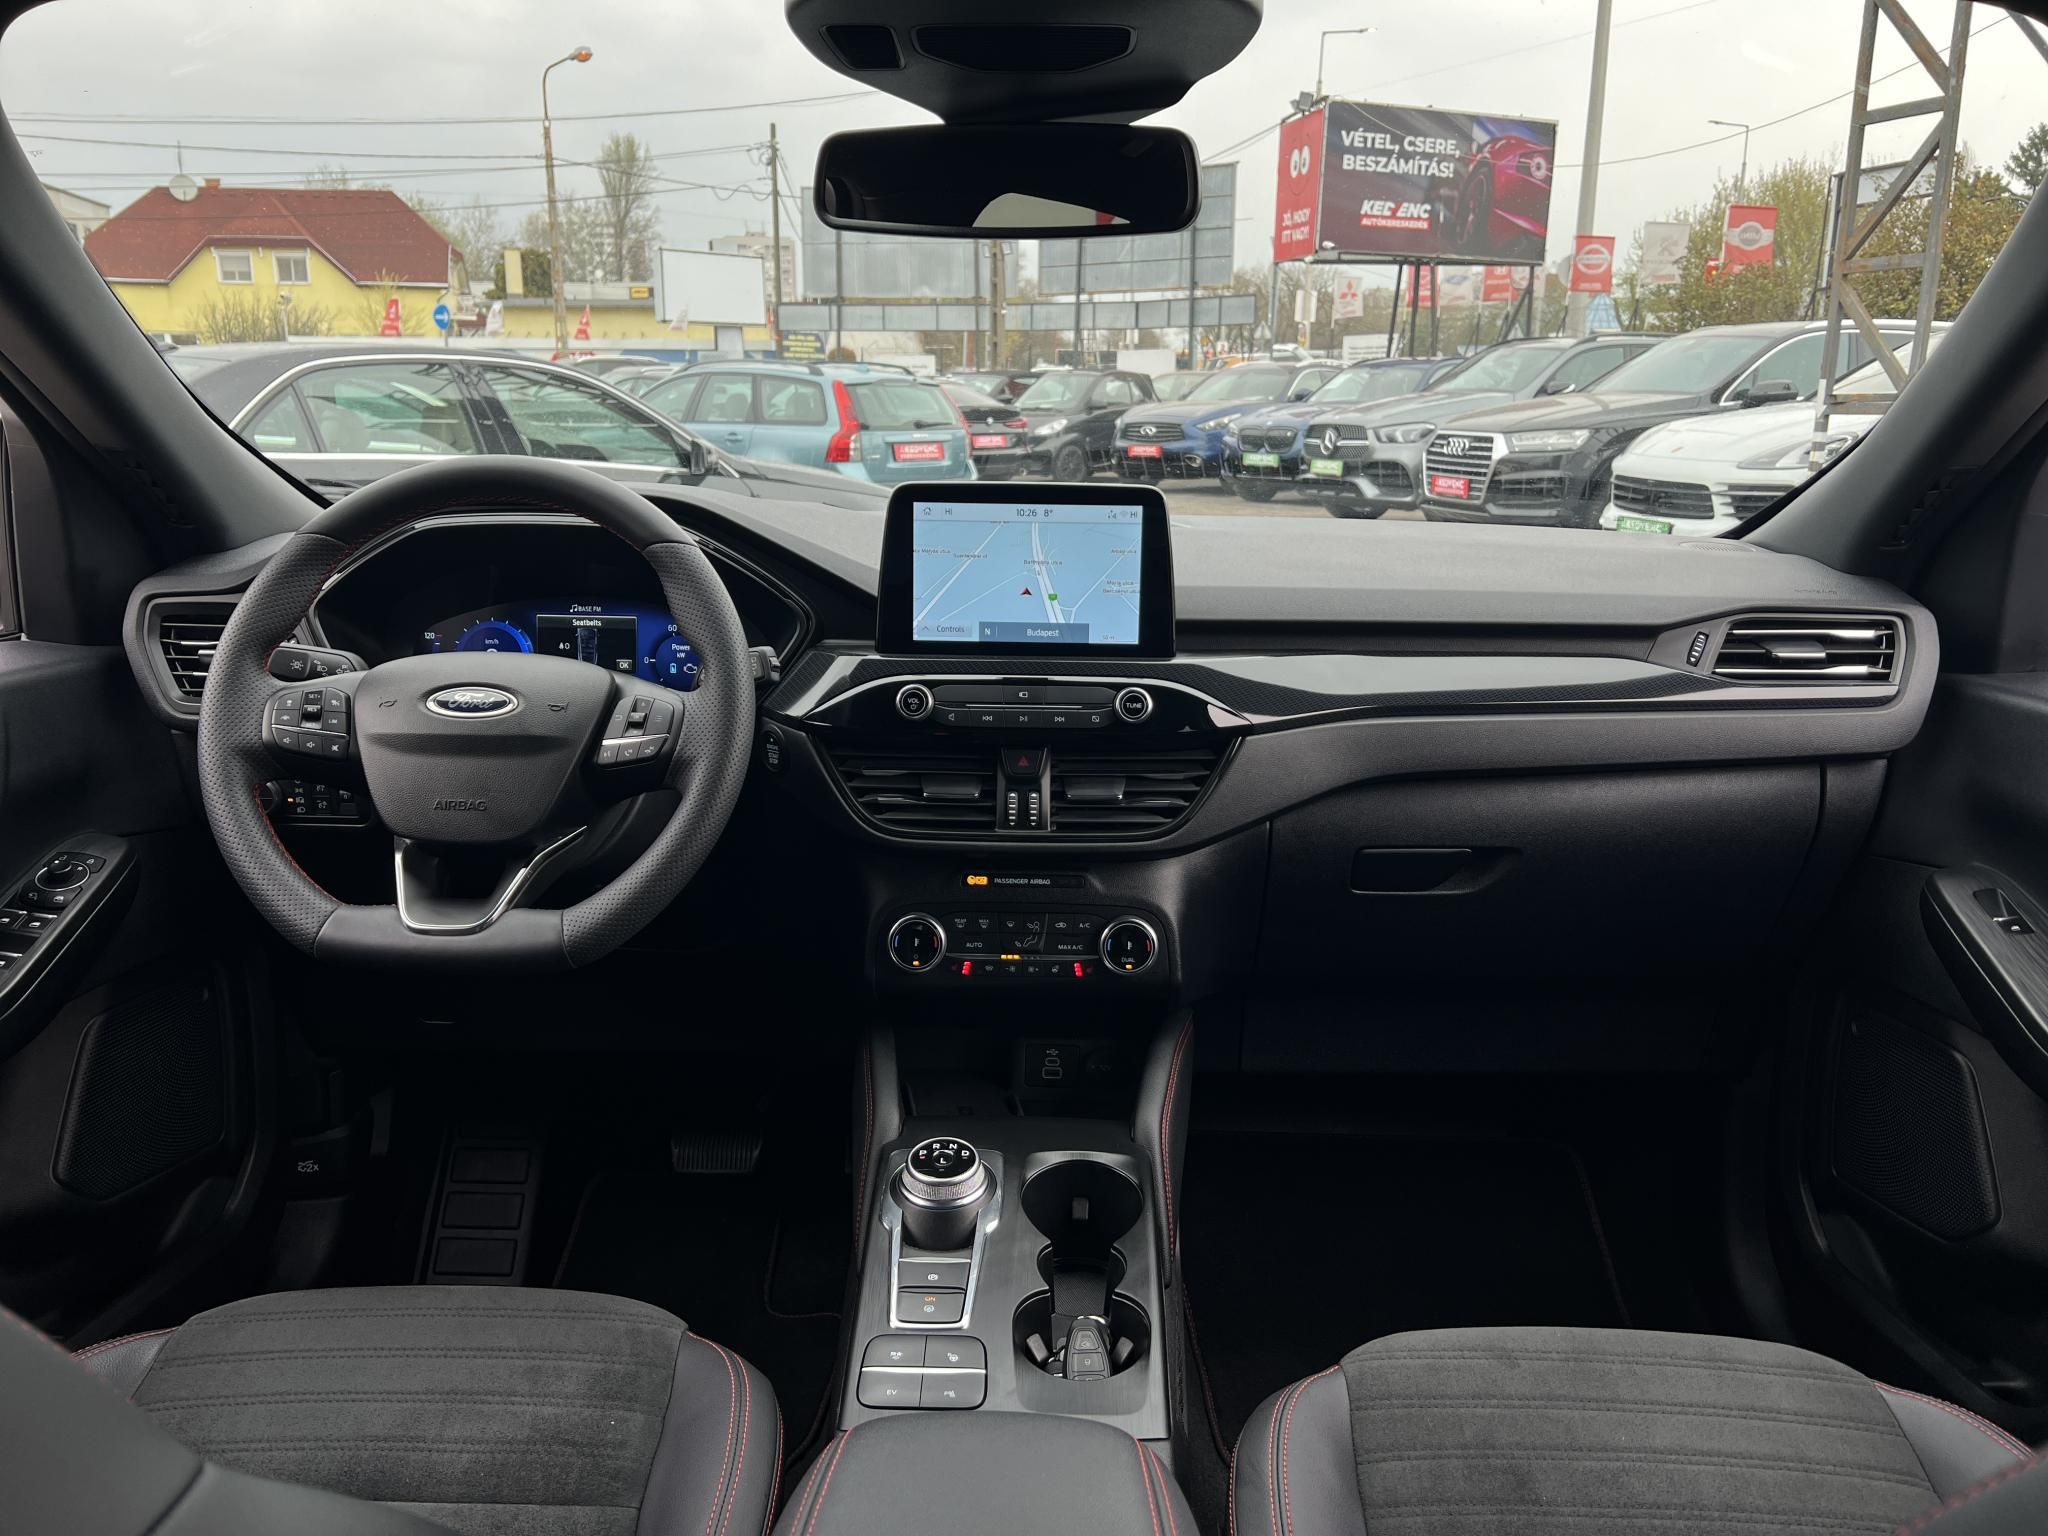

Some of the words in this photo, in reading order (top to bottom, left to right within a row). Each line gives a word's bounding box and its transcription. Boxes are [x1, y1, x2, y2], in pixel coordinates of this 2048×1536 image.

[1341, 128, 1400, 153] VÉTEL,
[1403, 136, 1460, 158] CSERE,
[1342, 154, 1455, 178] BESZÁMÍTÁS!
[1016, 508, 1038, 517] 10:26
[667, 624, 678, 632] 60
[936, 625, 965, 633] Controls
[1026, 629, 1060, 638] Budapest
[671, 643, 690, 651] Power
[448, 692, 494, 709] Ford
[432, 799, 488, 812] AIRBAG
[993, 877, 1029, 885] PASSENGER
